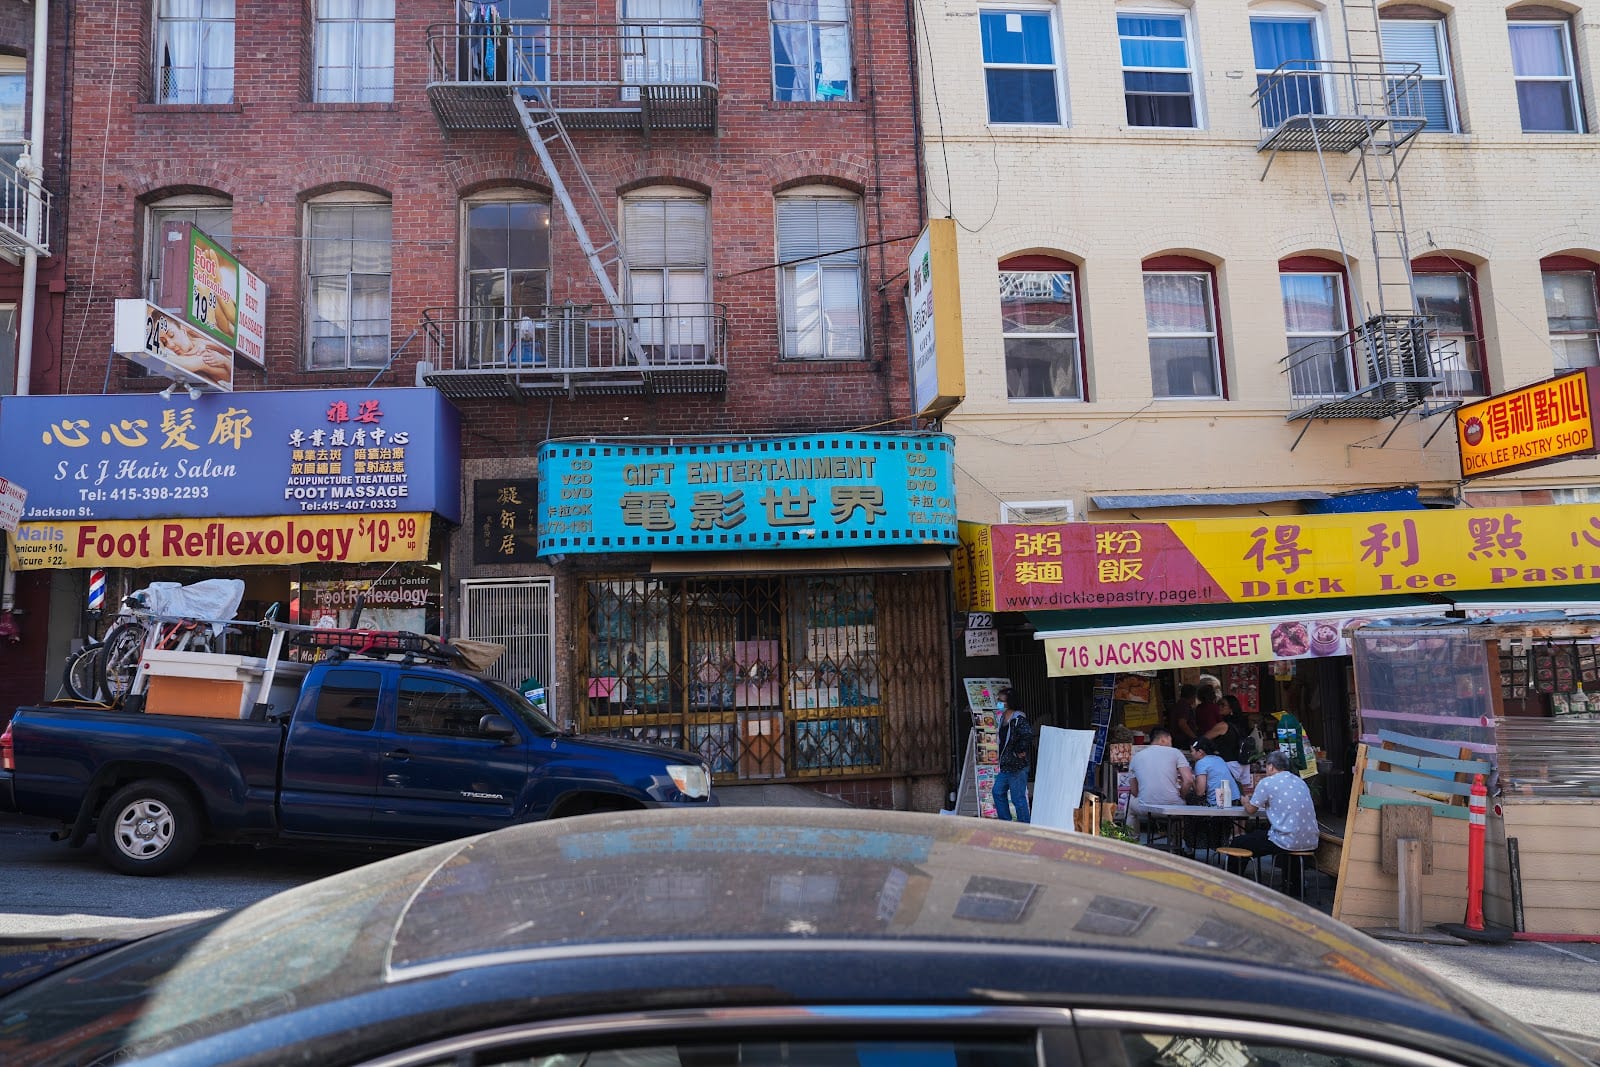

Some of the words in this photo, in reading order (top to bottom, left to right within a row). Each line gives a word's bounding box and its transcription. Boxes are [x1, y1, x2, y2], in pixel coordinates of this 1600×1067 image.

[193, 246, 217, 277] Foot
[193, 267, 231, 304] Reflexology
[246, 271, 257, 291] THE
[245, 292, 259, 313] BEST
[239, 311, 263, 339] MASSAGE
[1487, 378, 1588, 443] 得利點心
[42, 407, 253, 451] 心心髮廊
[906, 452, 927, 463] CD
[1465, 452, 1488, 471] DICK
[1491, 447, 1510, 465] LEE
[1512, 437, 1552, 459] PASTRY
[1556, 428, 1588, 450] SHOP
[54, 460, 69, 480] S
[74, 463, 89, 479] &
[94, 460, 111, 485] J
[114, 459, 170, 480] Hair
[174, 457, 237, 479] Salon
[571, 460, 592, 471] CD
[622, 463, 675, 486] GIFT
[687, 456, 876, 485] ENTERTAINMENT
[907, 466, 936, 477] VCD
[287, 476, 352, 485] ACUPUNCTURE
[355, 474, 408, 484] TREATMENT
[561, 474, 592, 485] VCD
[907, 480, 936, 491] DVD
[79, 488, 106, 501] Tel:
[110, 486, 209, 501] 415-398-2293
[285, 487, 327, 499] FOOT
[331, 485, 408, 498] MASSAGE
[561, 488, 592, 500] DVD
[28, 507, 76, 517] Jackson
[78, 506, 94, 517] St.
[619, 486, 887, 531] 電影世界
[17, 525, 64, 541] Nails
[76, 525, 150, 558] Foot
[162, 521, 354, 561] Reflexology
[358, 517, 416, 552] $19.99
[15, 543, 47, 553] anicure
[407, 541, 416, 550] up
[19, 556, 43, 566] icure
[400, 576, 430, 585] Center
[1240, 577, 1346, 598] Dick
[1380, 573, 1457, 591] Lee
[315, 588, 346, 605] Foot
[969, 614, 992, 628] 722
[1057, 645, 1089, 669] 716
[1094, 639, 1185, 667] JACKSON
[1190, 633, 1261, 660] STREET
